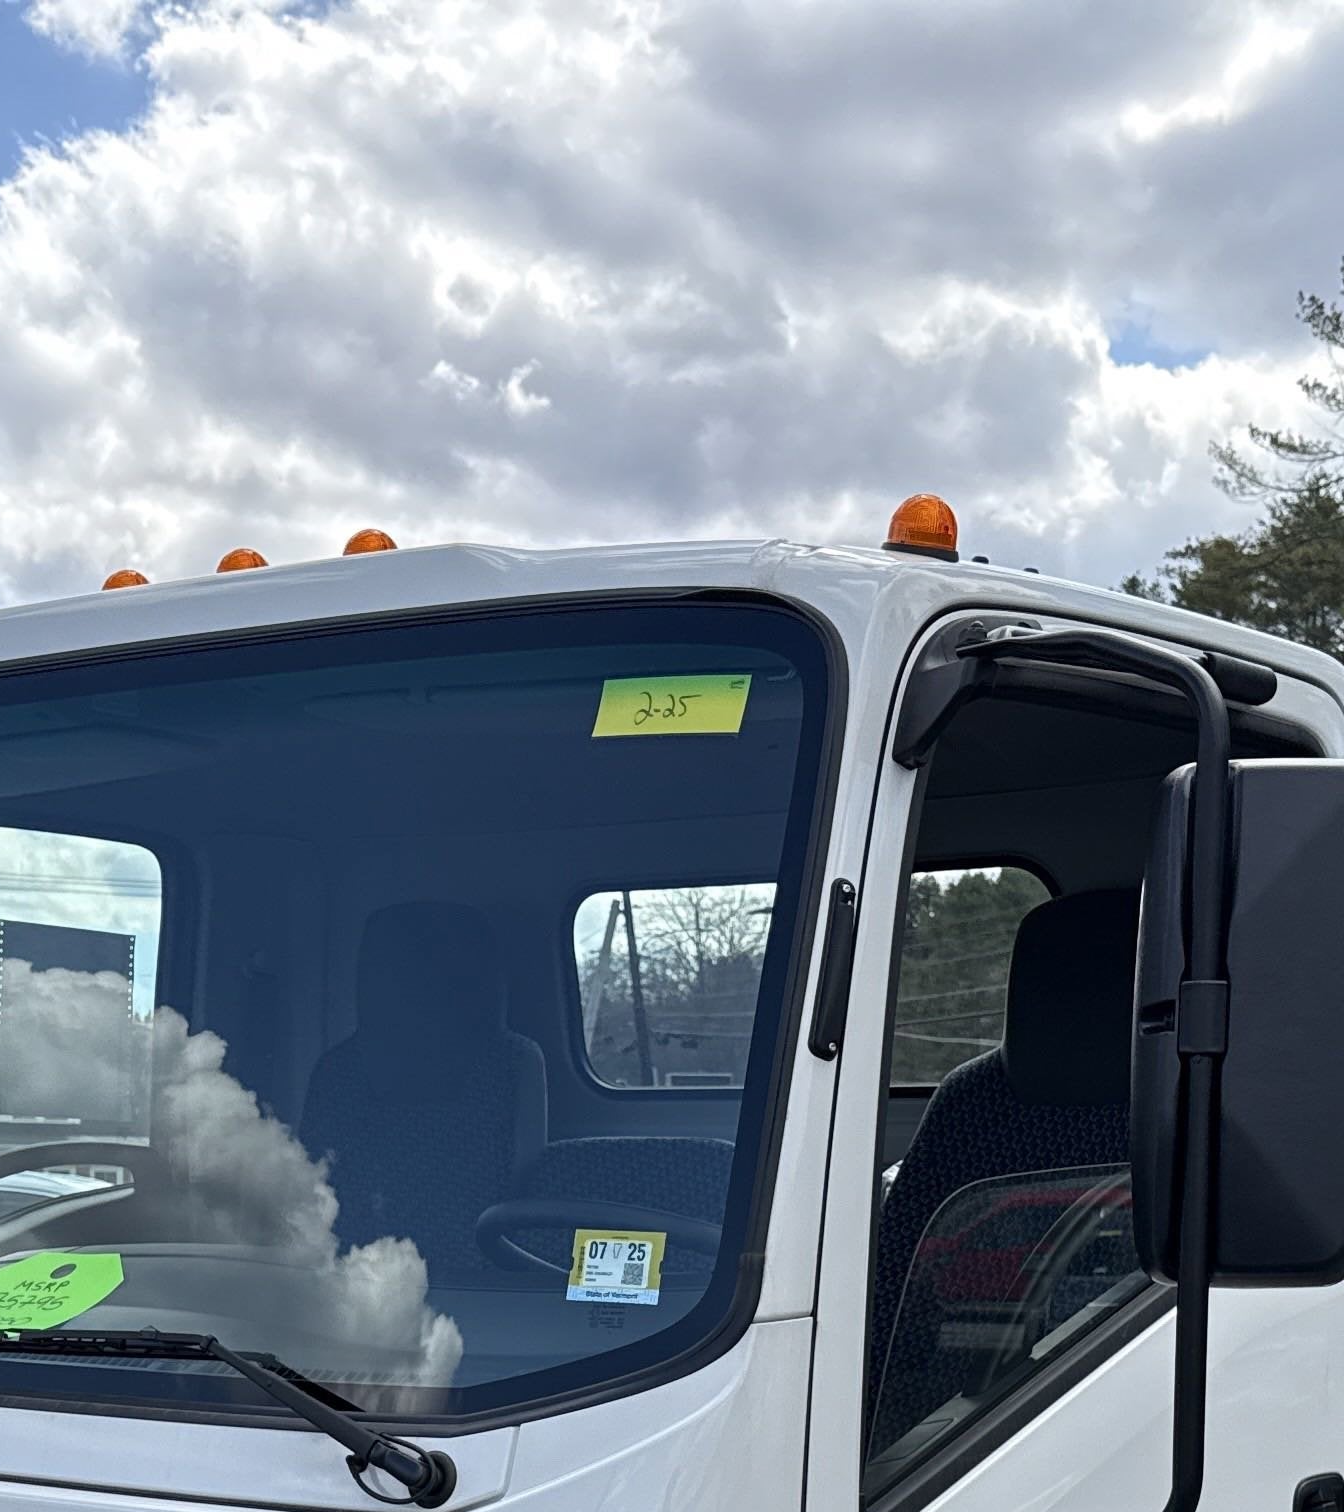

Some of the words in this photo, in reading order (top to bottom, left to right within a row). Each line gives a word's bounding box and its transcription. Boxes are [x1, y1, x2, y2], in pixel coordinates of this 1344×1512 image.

[633, 691, 703, 726] 2-25
[588, 1240, 608, 1260] 07
[627, 1242, 647, 1262] 25
[13, 1279, 70, 1293] MSRP
